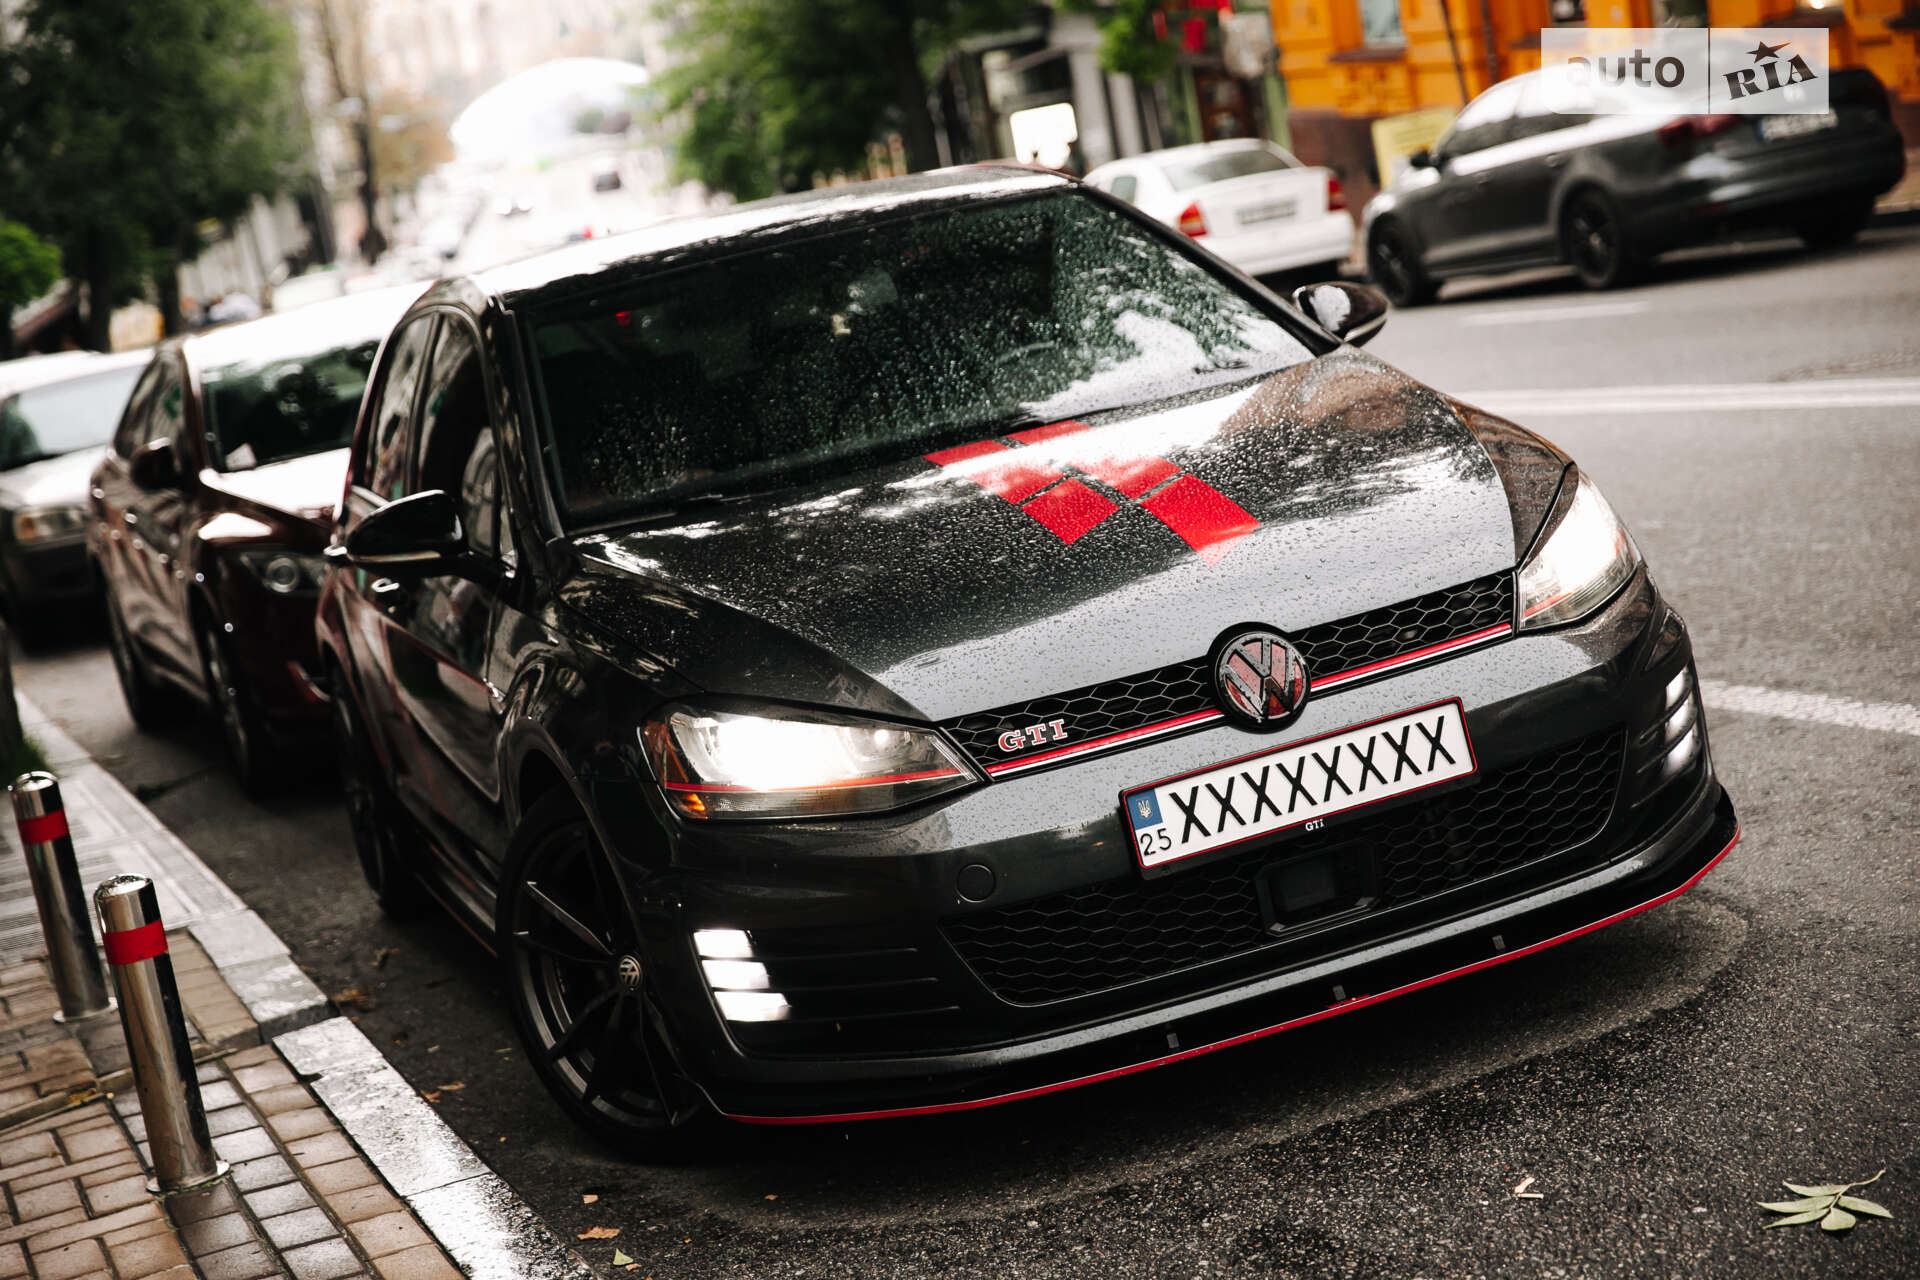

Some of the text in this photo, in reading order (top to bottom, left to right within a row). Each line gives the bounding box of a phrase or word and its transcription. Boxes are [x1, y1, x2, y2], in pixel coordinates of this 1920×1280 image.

[998, 718, 1068, 753] GTI
[1168, 715, 1456, 845] XXXXXXXX
[1139, 827, 1173, 857] 25
